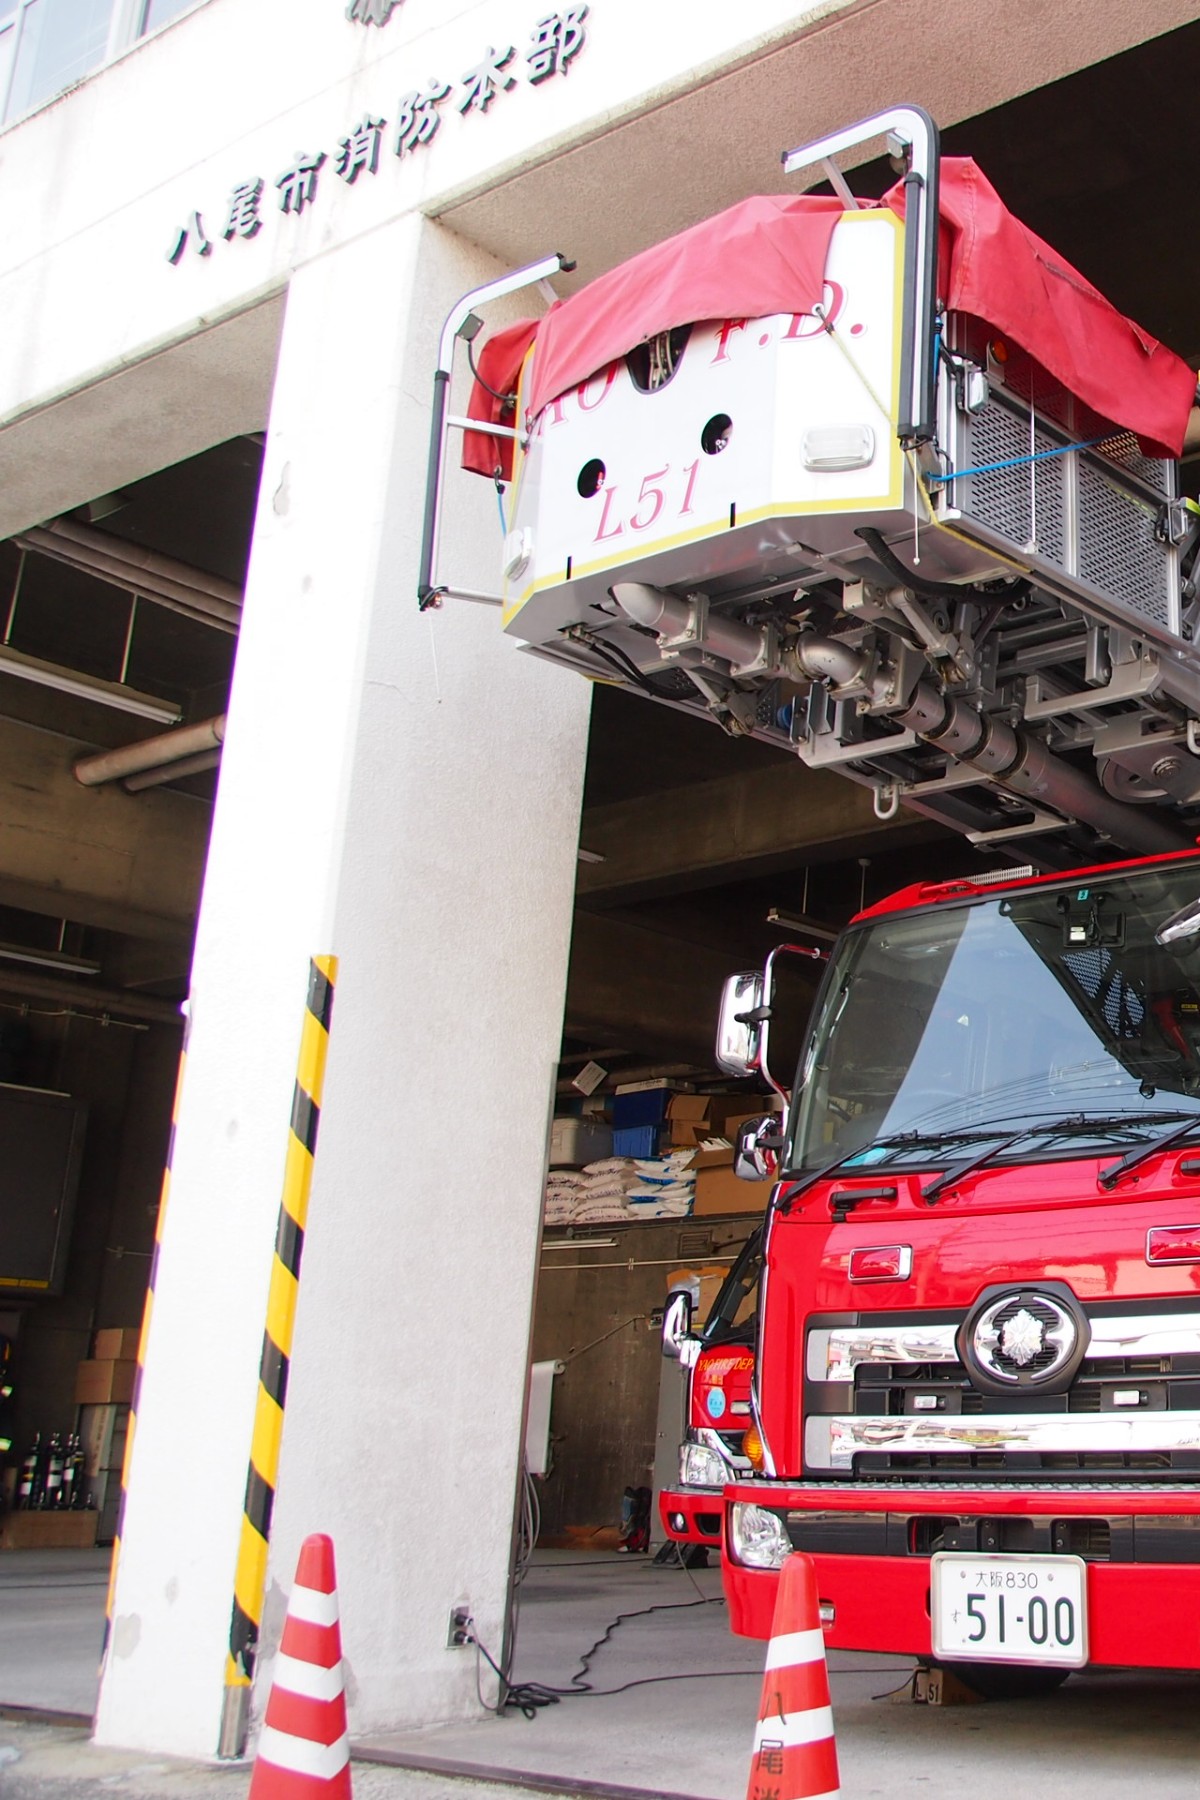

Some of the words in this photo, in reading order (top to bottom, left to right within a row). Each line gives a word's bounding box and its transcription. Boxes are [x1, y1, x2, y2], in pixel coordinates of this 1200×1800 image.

[165, 3, 590, 266] 八尾市消防本部
[592, 458, 700, 544] L51
[733, 1357, 755, 1371] DEP
[967, 1593, 1075, 1646] 51-00
